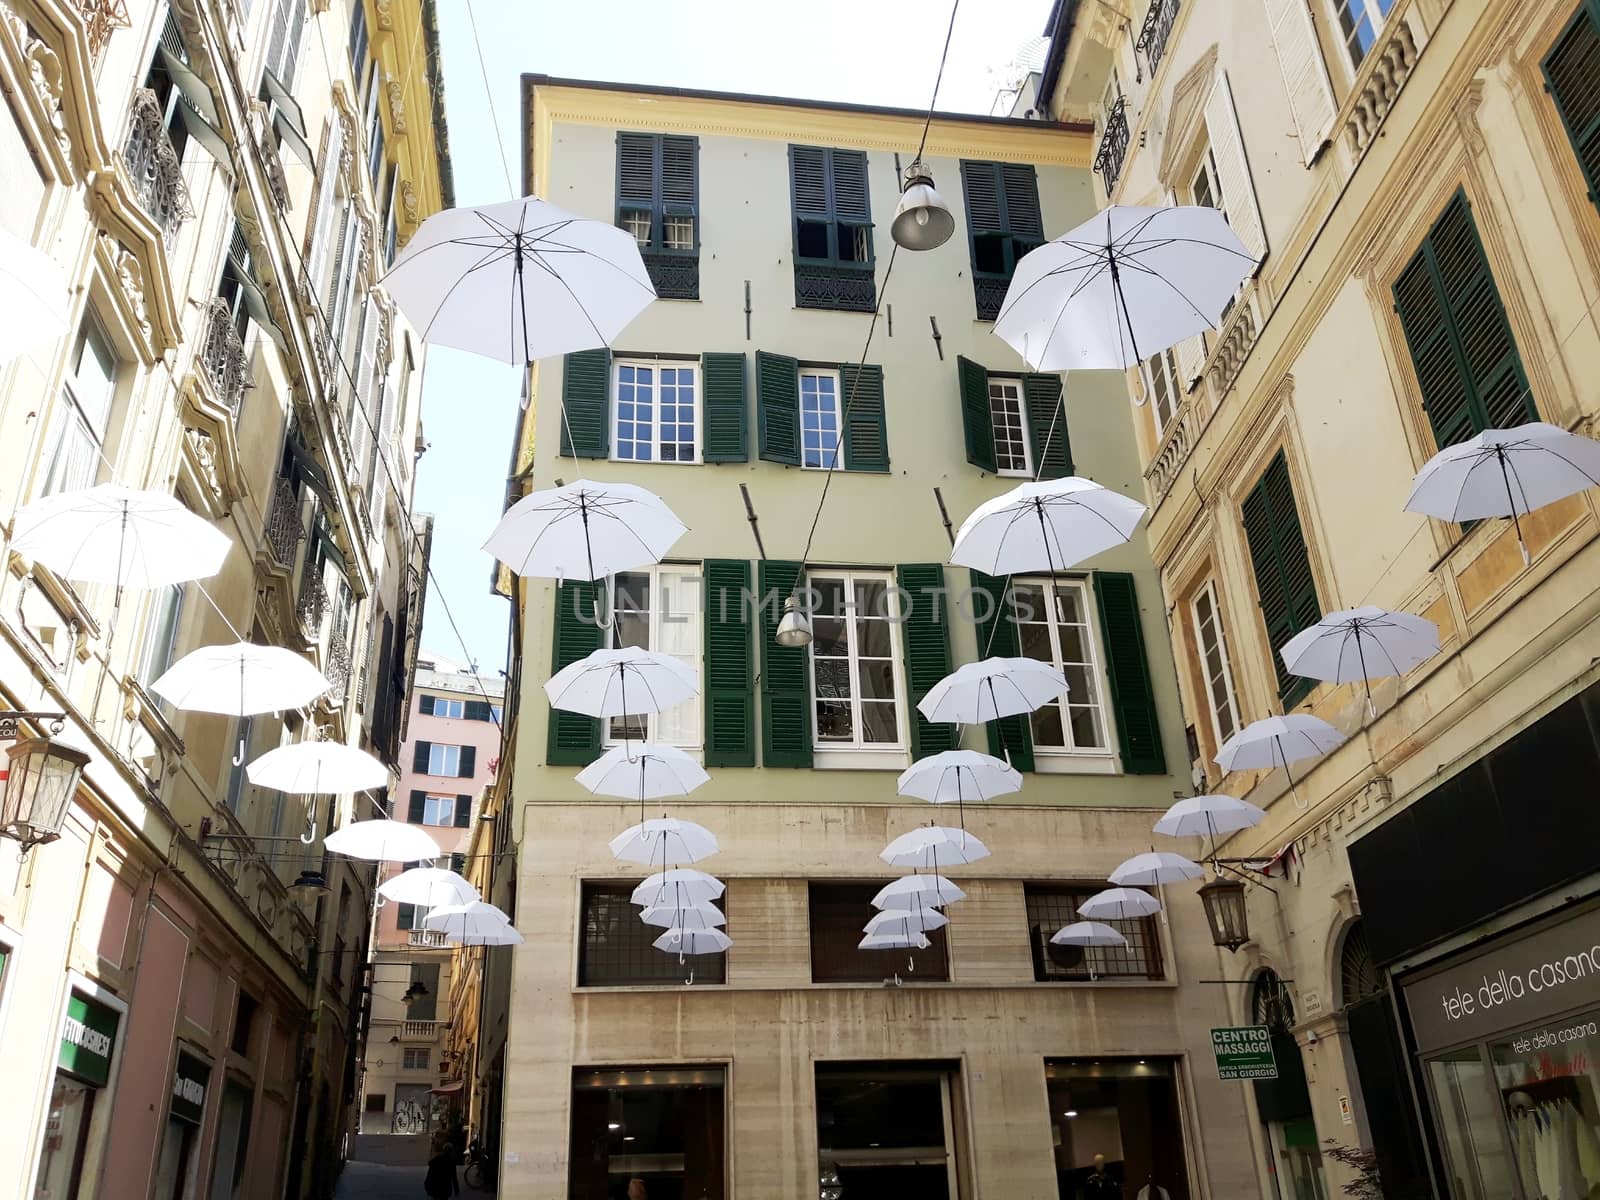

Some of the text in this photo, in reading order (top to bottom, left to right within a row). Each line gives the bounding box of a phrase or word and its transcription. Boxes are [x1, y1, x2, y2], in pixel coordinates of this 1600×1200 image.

[1442, 986, 1475, 1020] tele
[1478, 969, 1525, 1009] della
[1213, 1030, 1267, 1042] CENTRO
[1513, 1022, 1597, 1054] tele della casana
[1215, 1042, 1270, 1055] MASSAGGI
[1220, 1068, 1276, 1079] SAN GIORGIO
